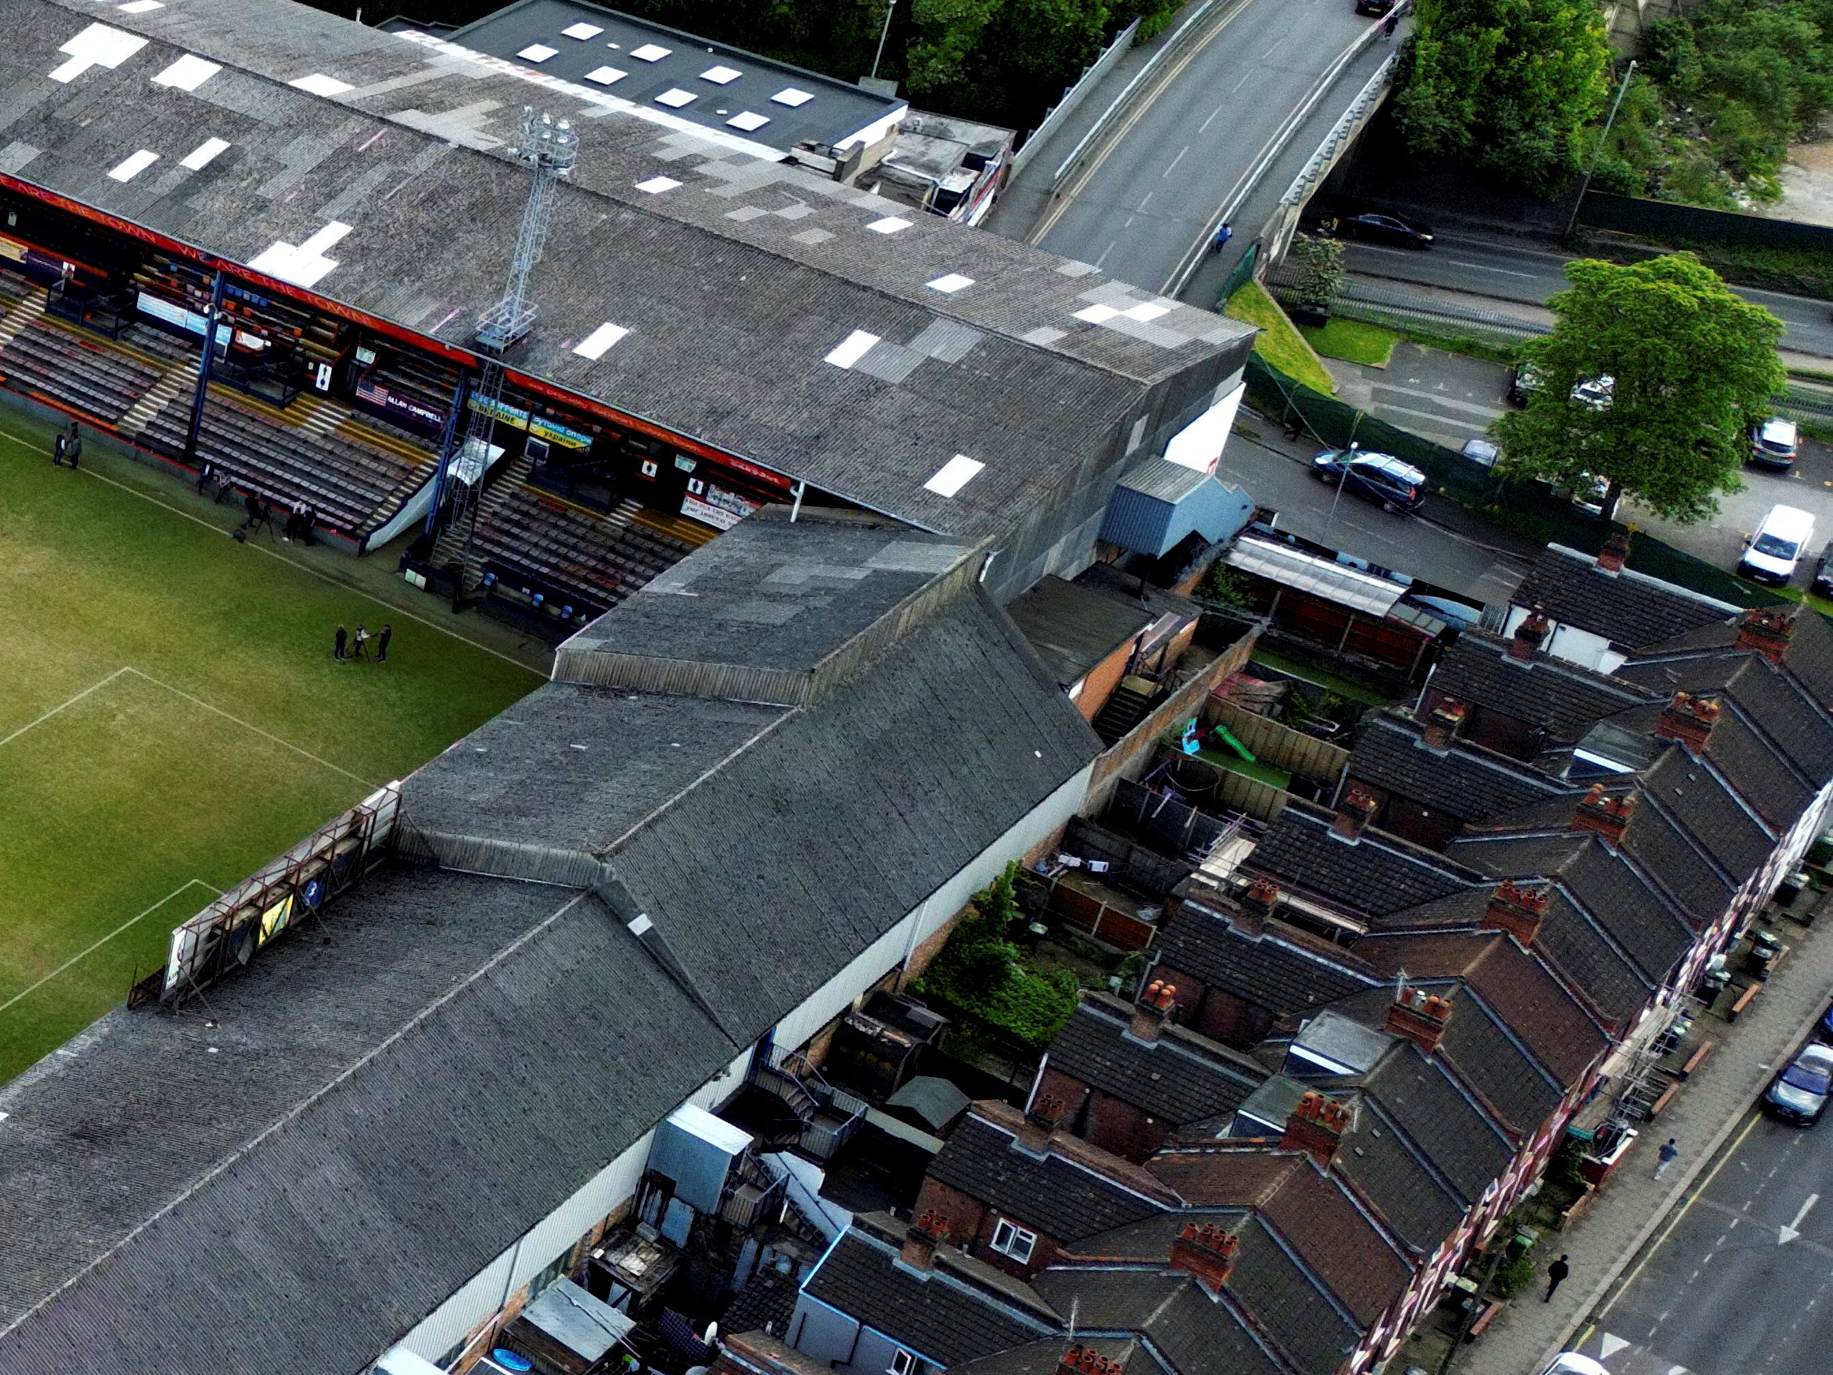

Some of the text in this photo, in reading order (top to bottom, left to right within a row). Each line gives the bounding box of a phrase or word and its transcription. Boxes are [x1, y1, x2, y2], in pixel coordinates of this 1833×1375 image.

[17, 182, 55, 203] ARE
[58, 199, 90, 216] THE
[100, 215, 157, 244] TOWN
[216, 261, 255, 279] ARE
[261, 280, 295, 296] THE
[387, 395, 442, 423] ALLAN CAMPBELL
